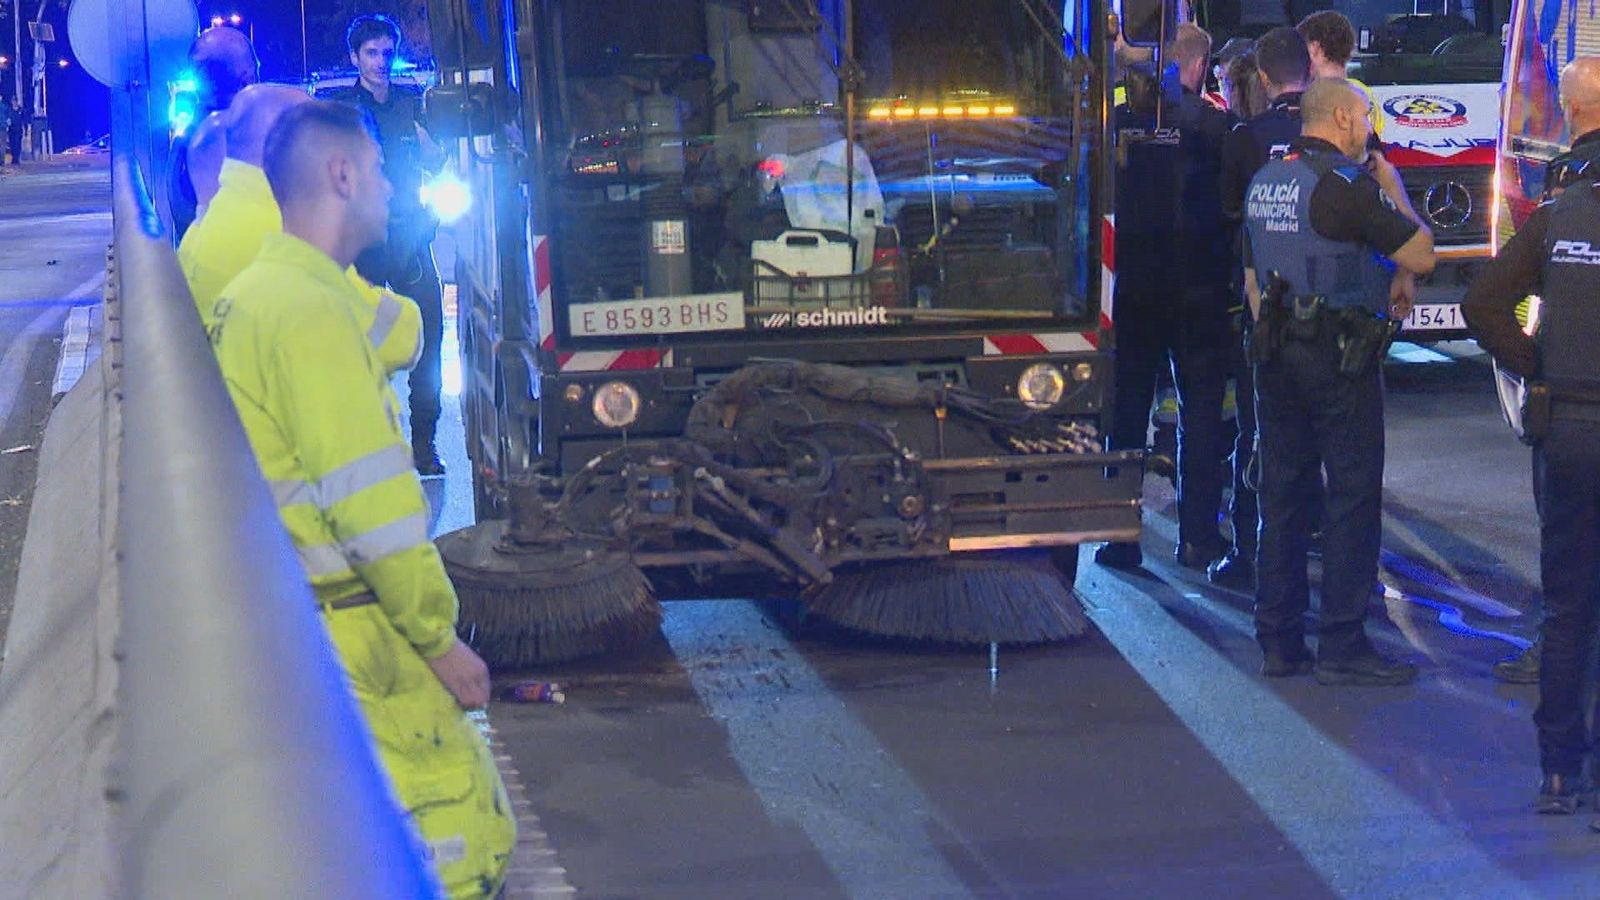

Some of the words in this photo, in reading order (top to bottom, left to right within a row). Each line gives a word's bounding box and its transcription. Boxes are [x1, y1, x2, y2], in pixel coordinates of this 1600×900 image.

[1249, 178, 1300, 203] POLICÍA
[1247, 202, 1298, 219] MUNICIPAL
[1265, 219, 1299, 232] Madrid
[583, 311, 597, 333] E
[606, 306, 672, 330] 8593
[680, 301, 728, 326] BHS
[797, 306, 888, 326] schmidt
[1408, 307, 1456, 327] 1541
